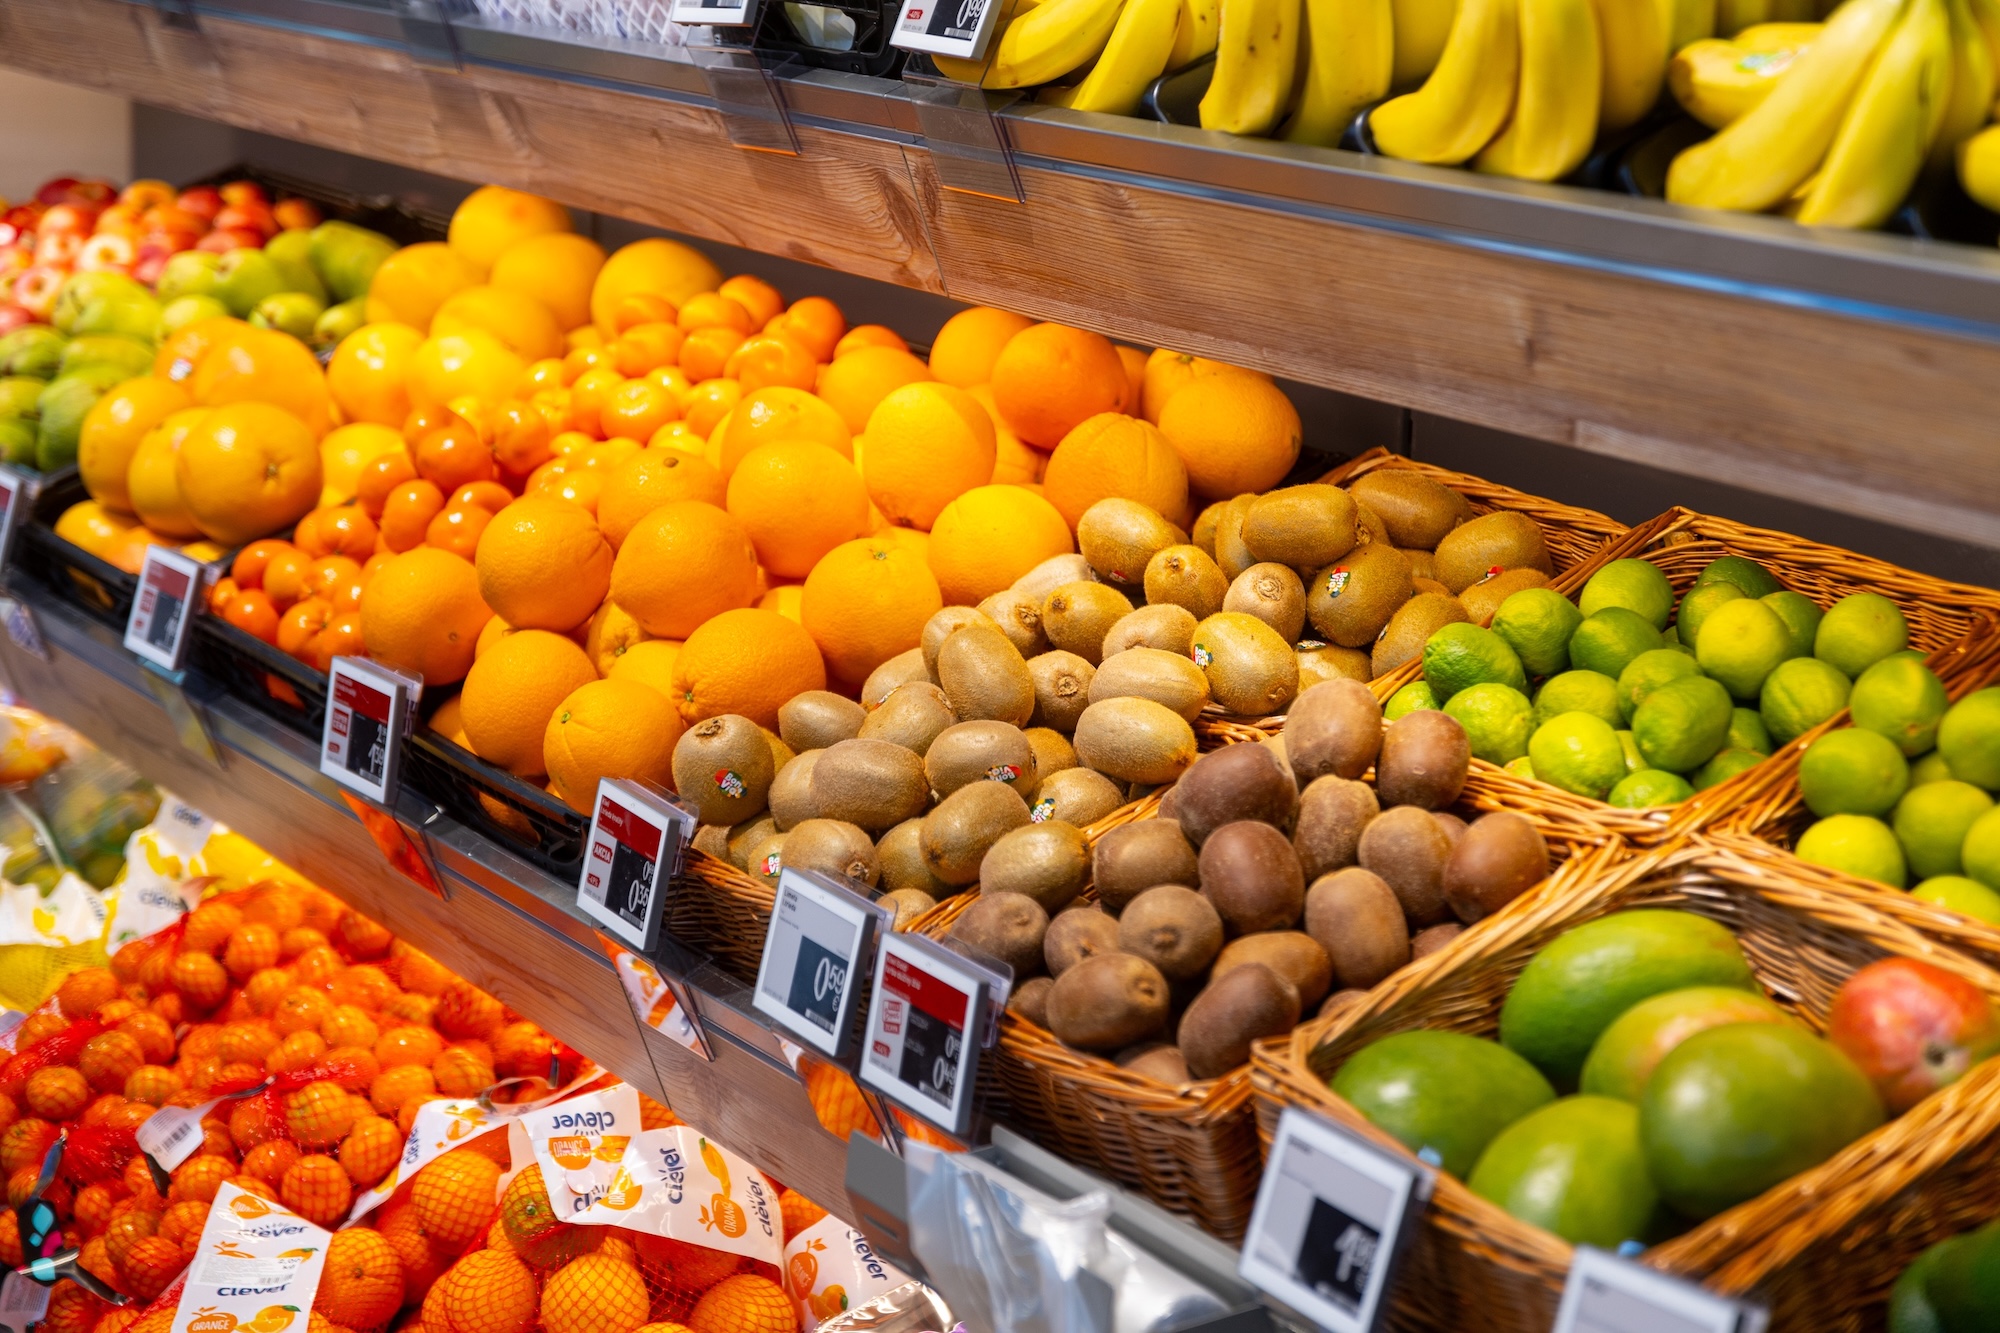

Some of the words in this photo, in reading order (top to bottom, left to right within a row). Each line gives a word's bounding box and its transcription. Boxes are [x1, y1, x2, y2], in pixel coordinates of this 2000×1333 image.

[594, 845, 612, 863] AKCIA
[552, 1111, 615, 1131] clever
[747, 1176, 773, 1237] clever
[217, 1283, 291, 1297] clever
[192, 1319, 230, 1331] ORANGE
